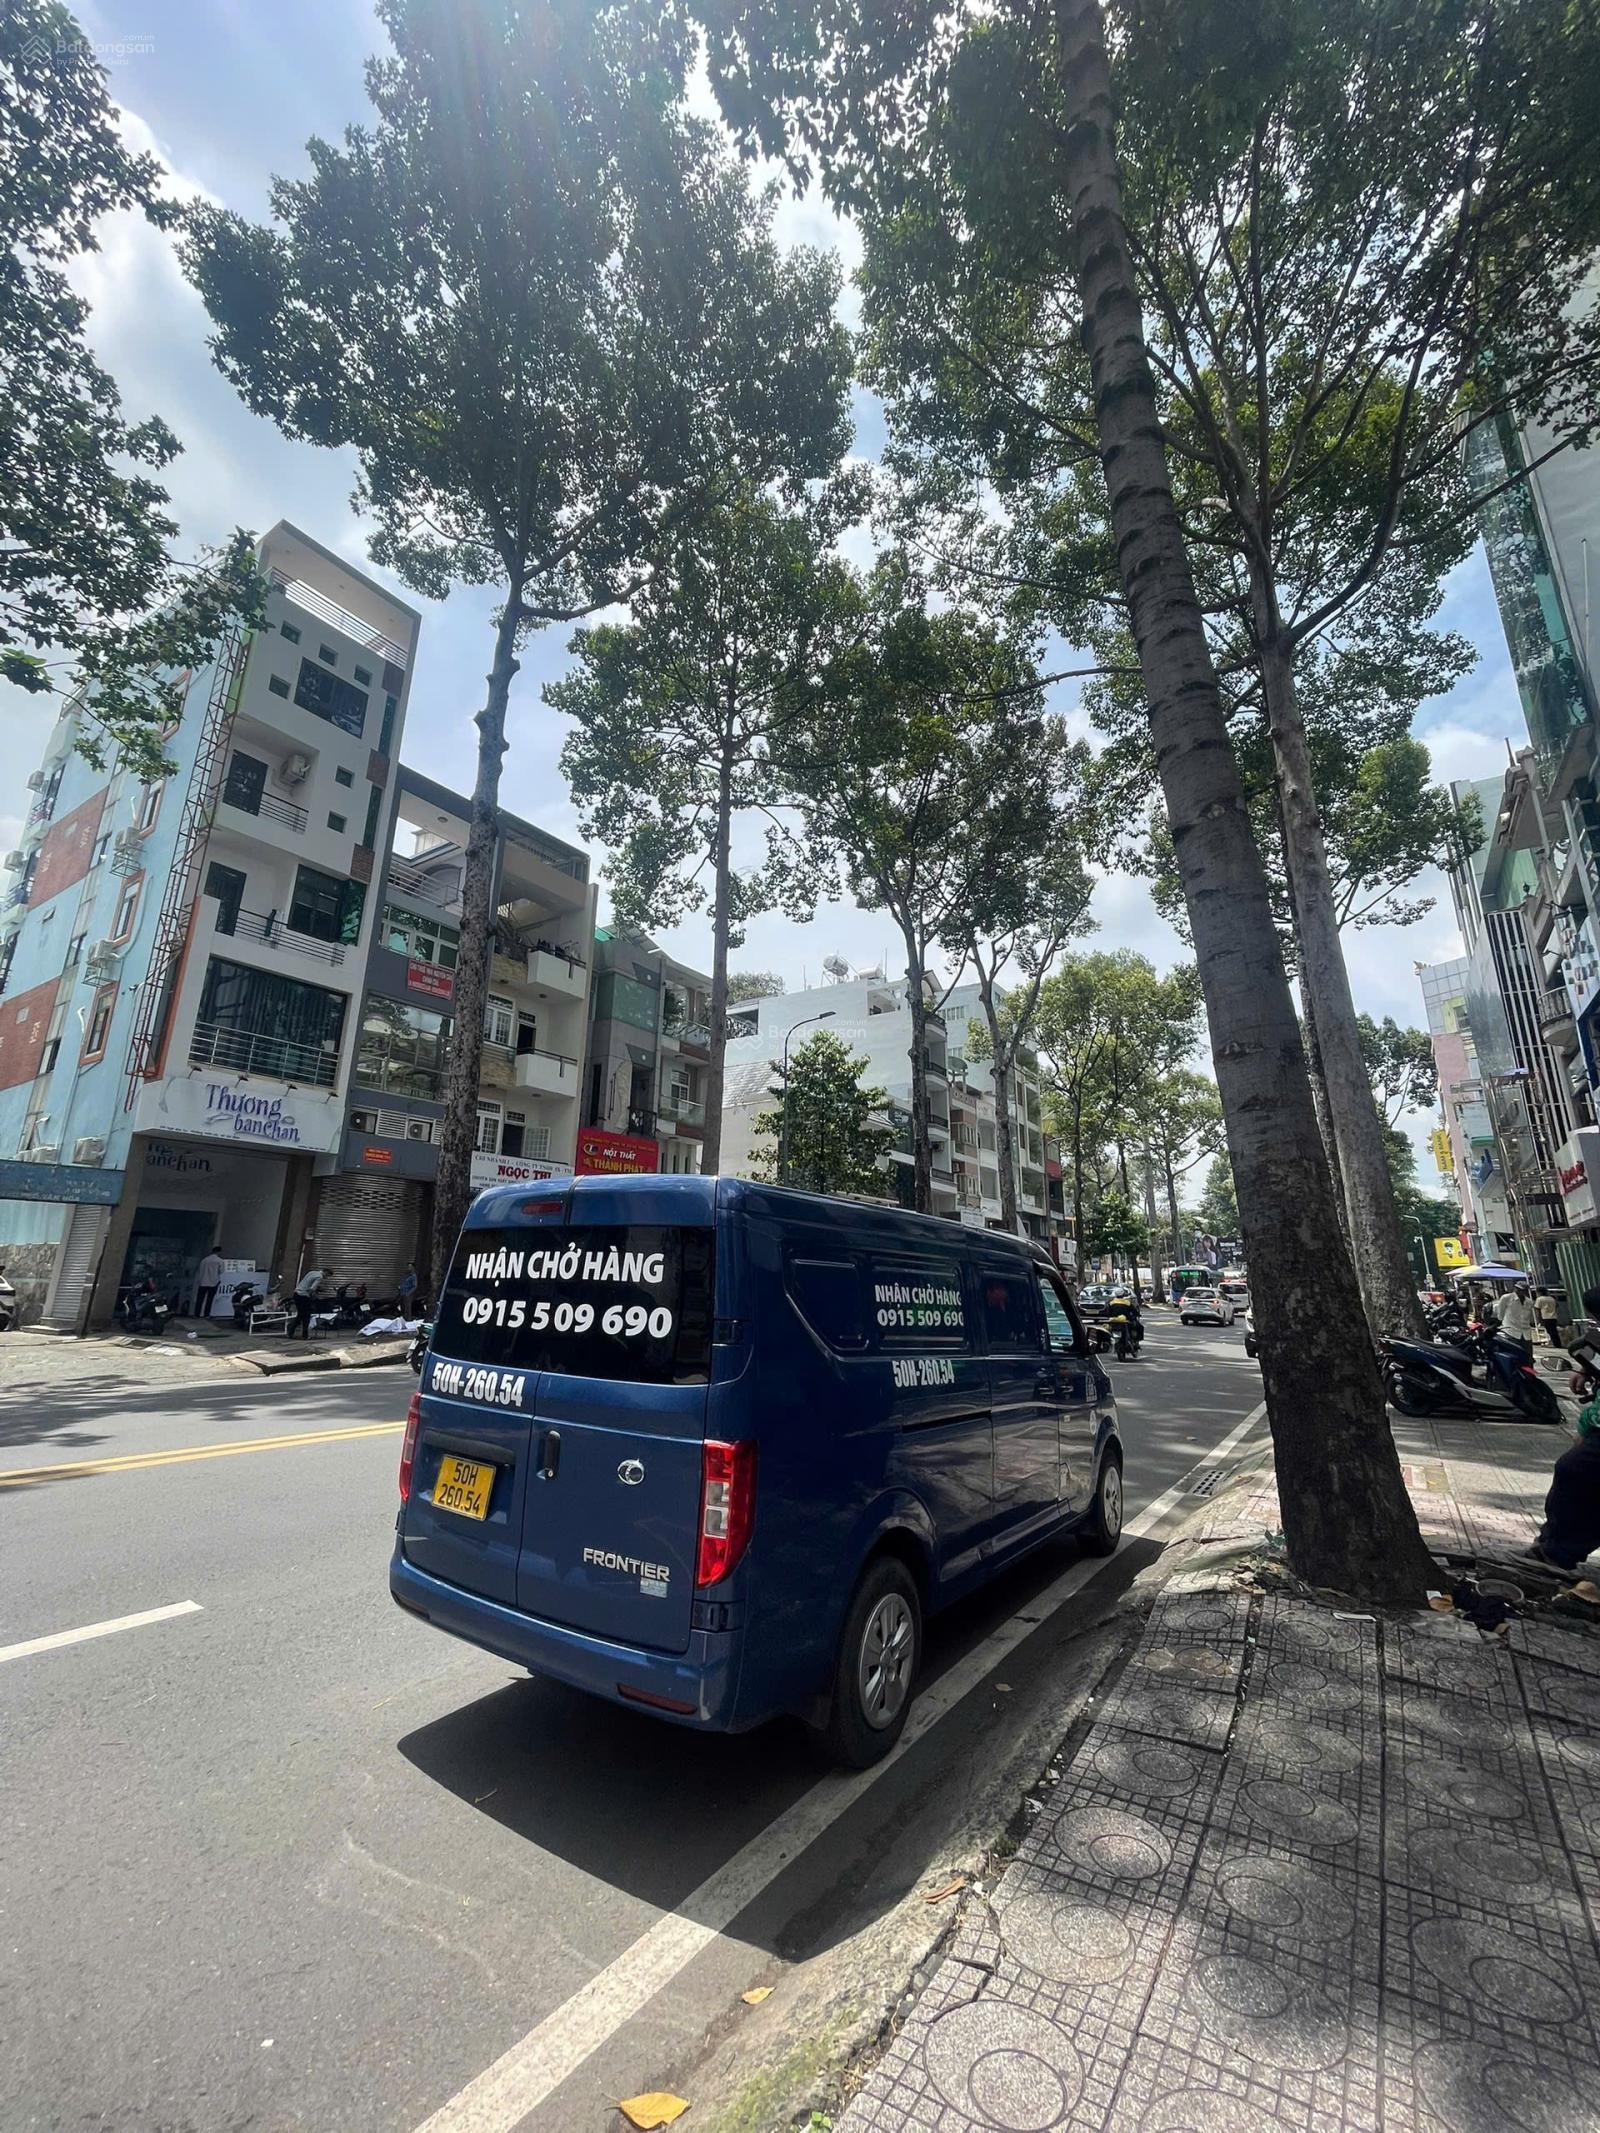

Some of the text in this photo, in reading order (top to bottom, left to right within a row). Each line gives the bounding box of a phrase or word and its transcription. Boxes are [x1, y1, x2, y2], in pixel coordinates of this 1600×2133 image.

[234, 1113, 301, 1142] banchan
[603, 1148, 618, 1159] NỘI
[498, 1165, 530, 1180] NGỌC
[465, 1242, 665, 1287] NHẬN CHỞ HÀNG
[875, 1282, 911, 1308] NHẬN
[911, 1283, 935, 1304] CHỞ
[463, 1297, 672, 1338] 0915 509 690
[877, 1309, 915, 1327] 0915
[917, 1310, 942, 1327] 509
[431, 1362, 526, 1407] 50H-260.54
[892, 1360, 955, 1387] 50H-260.54
[453, 1462, 479, 1487] 50H
[438, 1483, 481, 1515] 260.54
[583, 1547, 671, 1582] FRONTIER
